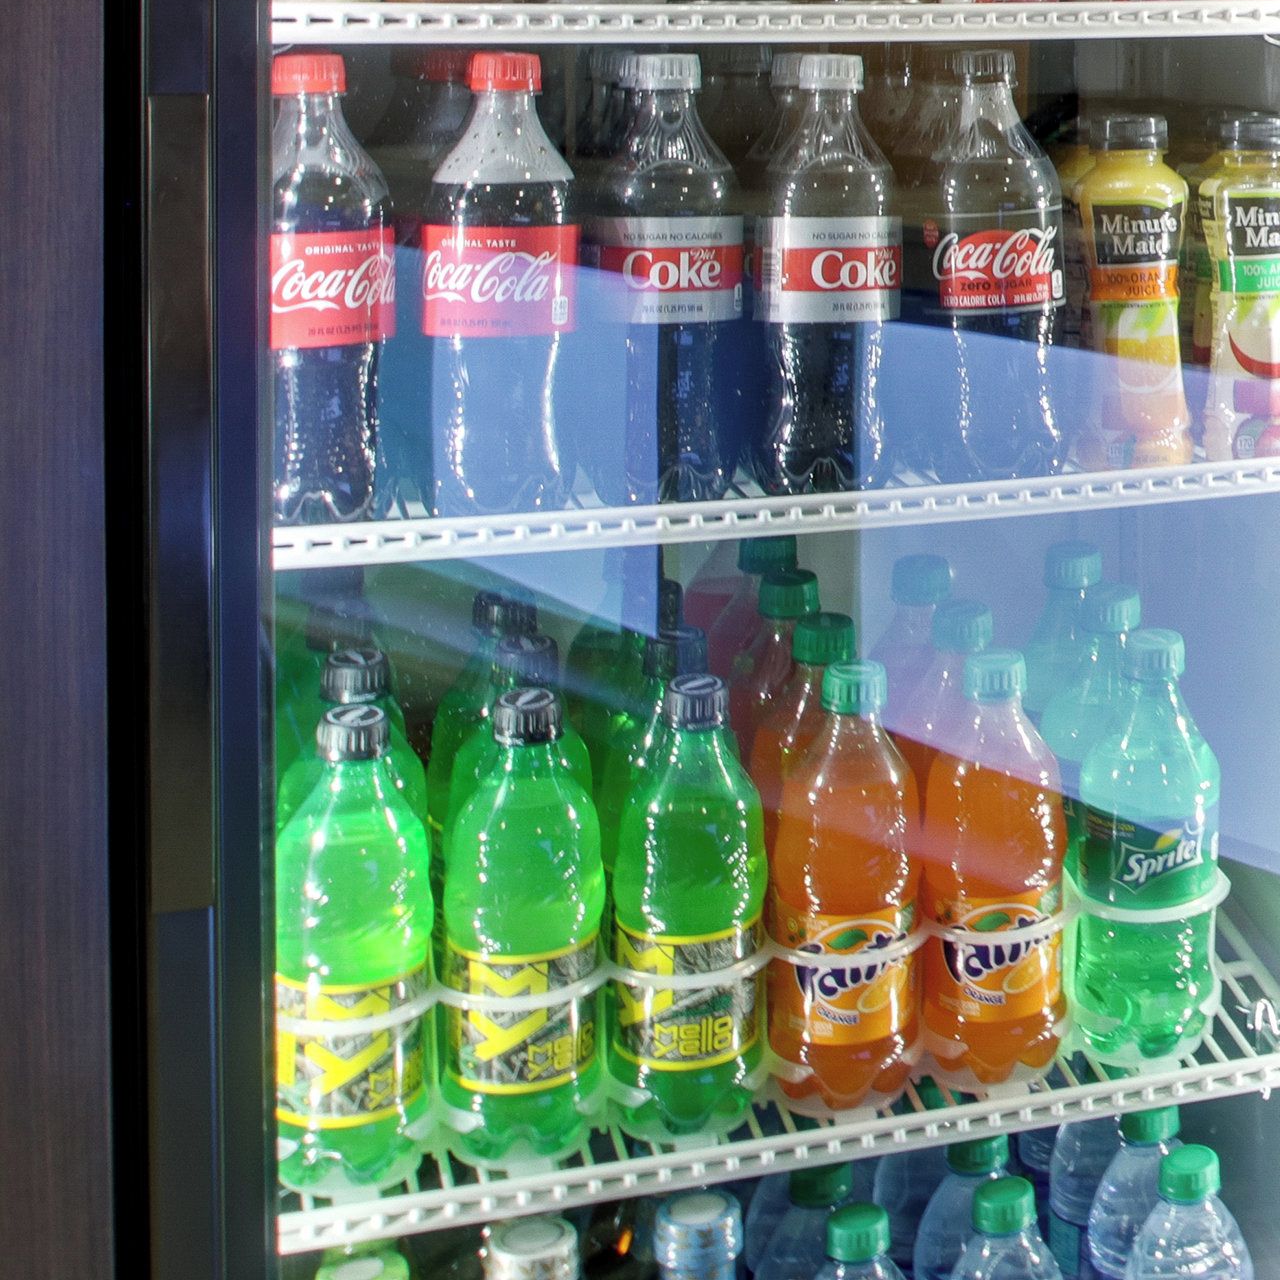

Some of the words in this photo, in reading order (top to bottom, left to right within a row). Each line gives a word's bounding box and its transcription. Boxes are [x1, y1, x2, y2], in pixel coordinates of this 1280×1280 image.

[1101, 211, 1178, 234] Minute
[486, 239, 517, 248] TASTE
[669, 232, 684, 240] NO
[685, 232, 722, 240] CALORIES
[827, 232, 857, 240] SUGAR
[1112, 232, 1171, 256] Maid
[305, 243, 354, 256] ORIGINAL
[691, 248, 716, 261] Diet
[932, 225, 1058, 280] Coca-Cola
[423, 250, 558, 304] Coca-Cola
[622, 250, 721, 290] Coke
[810, 250, 897, 289] Coke
[1242, 265, 1267, 275] 100%
[271, 254, 396, 314] Coca-Cola
[994, 278, 1032, 289] SUGAR
[943, 295, 959, 306] ZERO
[959, 295, 987, 306] CALORIE
[988, 294, 1006, 305] COLA
[1122, 839, 1197, 883] Sprite
